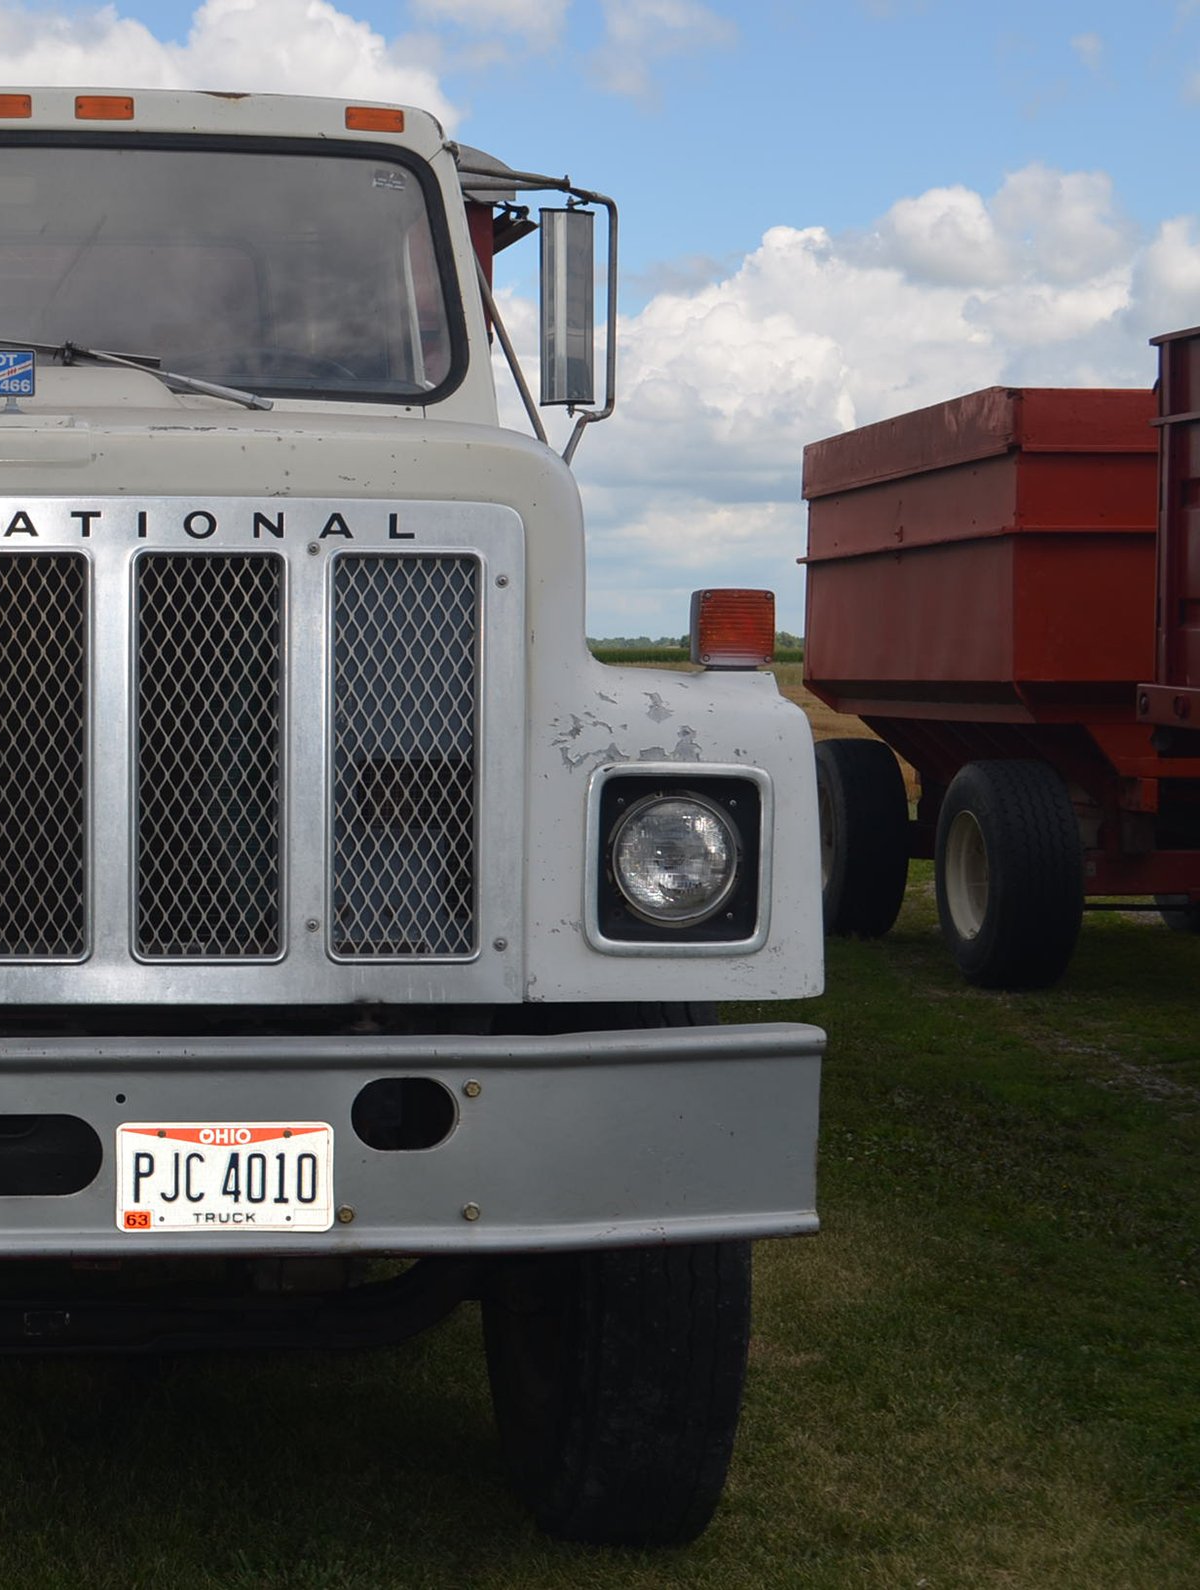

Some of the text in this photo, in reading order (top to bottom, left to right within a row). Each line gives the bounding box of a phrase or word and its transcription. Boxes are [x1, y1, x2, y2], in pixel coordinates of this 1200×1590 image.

[0, 379, 31, 392] 466
[199, 1129, 251, 1144] OHIO
[133, 1153, 317, 1203] PJC 4010
[126, 1214, 148, 1226] 63
[193, 1213, 256, 1223] TRUCK
